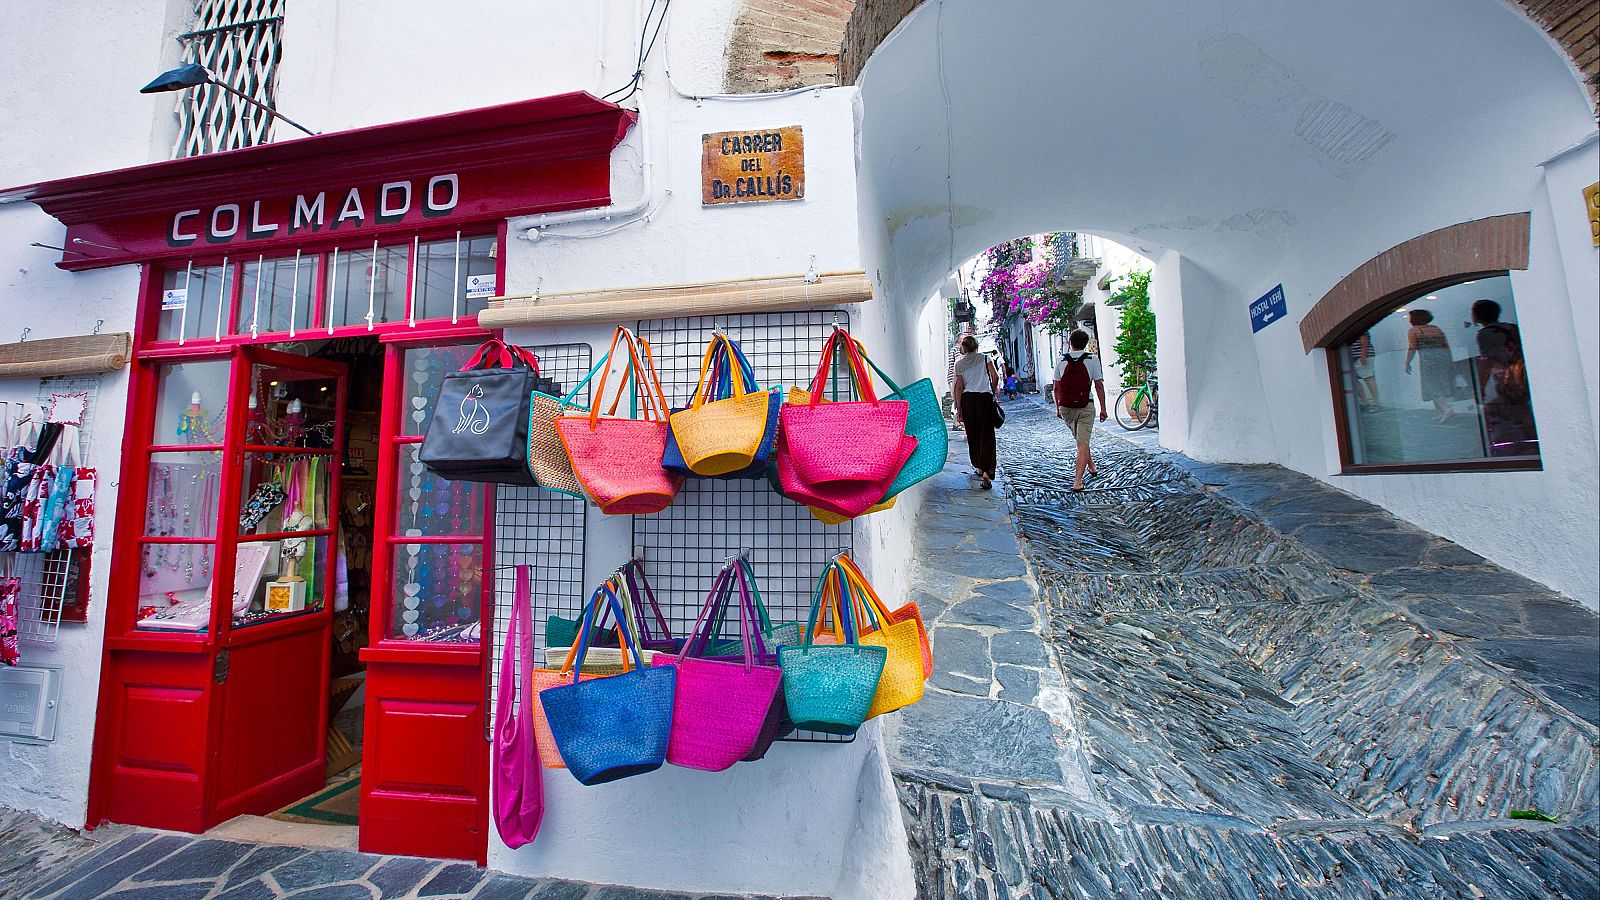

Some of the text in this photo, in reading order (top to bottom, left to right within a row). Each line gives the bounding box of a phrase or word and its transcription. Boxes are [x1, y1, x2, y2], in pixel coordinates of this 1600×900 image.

[722, 133, 782, 155] CARRER
[741, 157, 762, 172] DEL
[171, 173, 459, 242] COLMADO
[1251, 299, 1269, 318] HOSTAL
